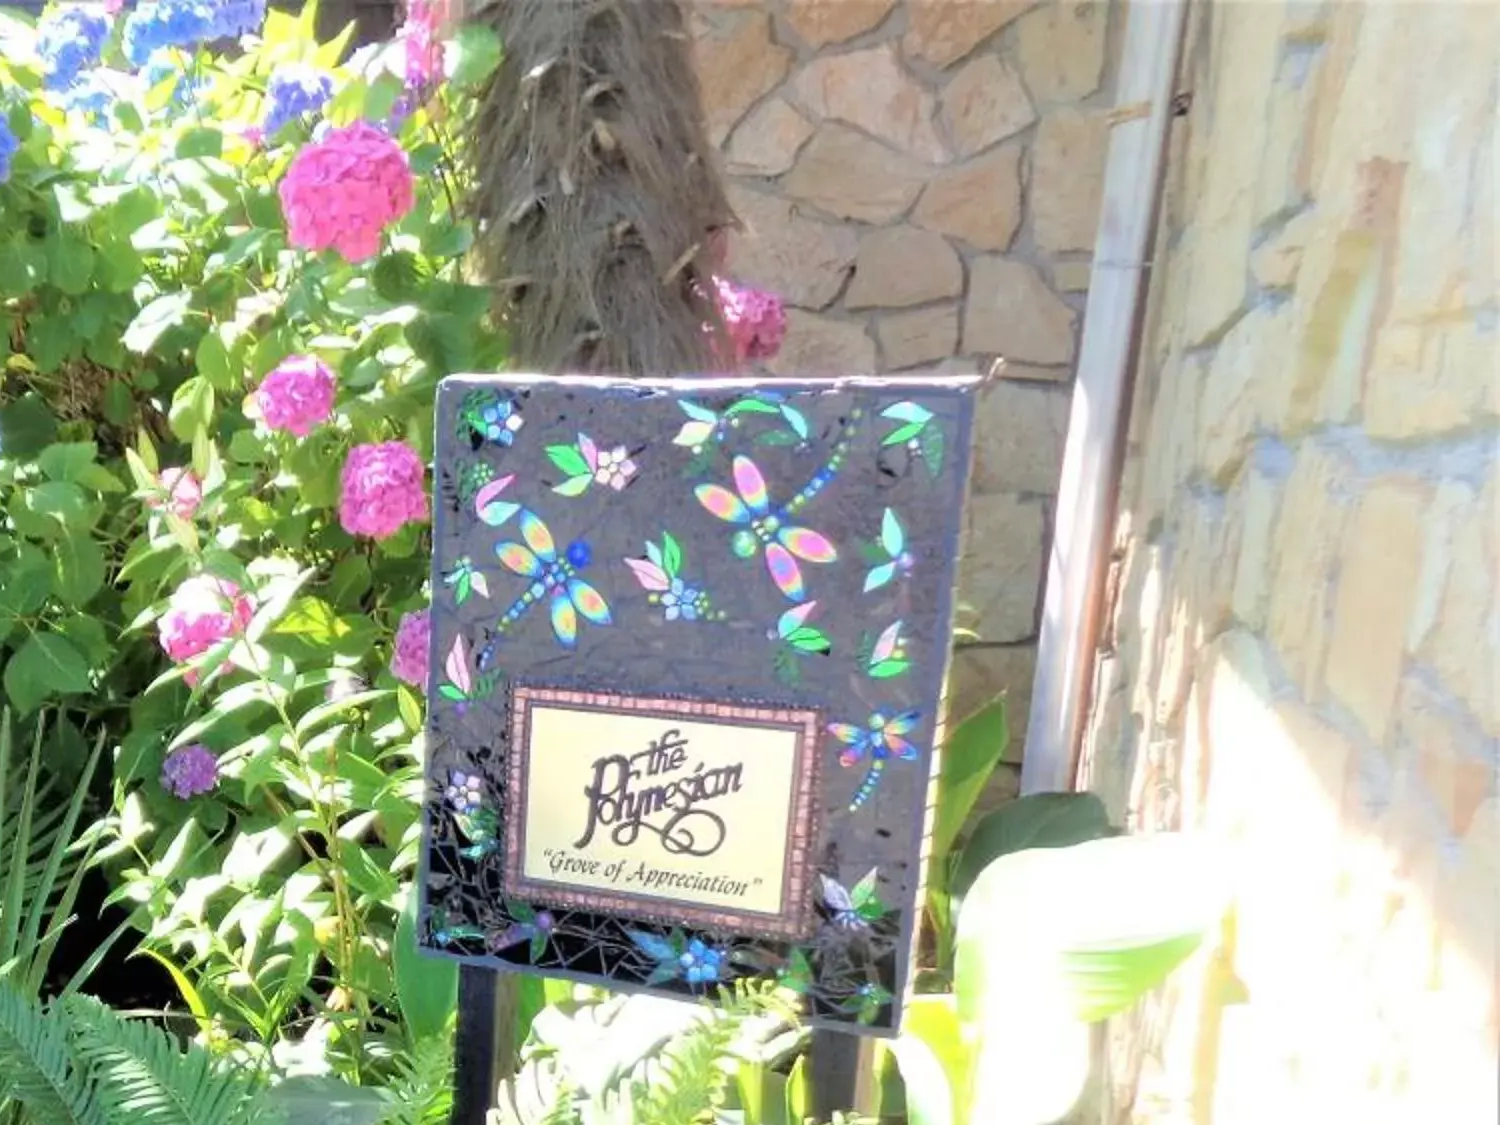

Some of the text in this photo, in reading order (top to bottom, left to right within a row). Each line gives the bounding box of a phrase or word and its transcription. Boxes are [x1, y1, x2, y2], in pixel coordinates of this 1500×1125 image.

[630, 729, 689, 777] the
[573, 753, 744, 857] Polynesian
[603, 859, 627, 883] of
